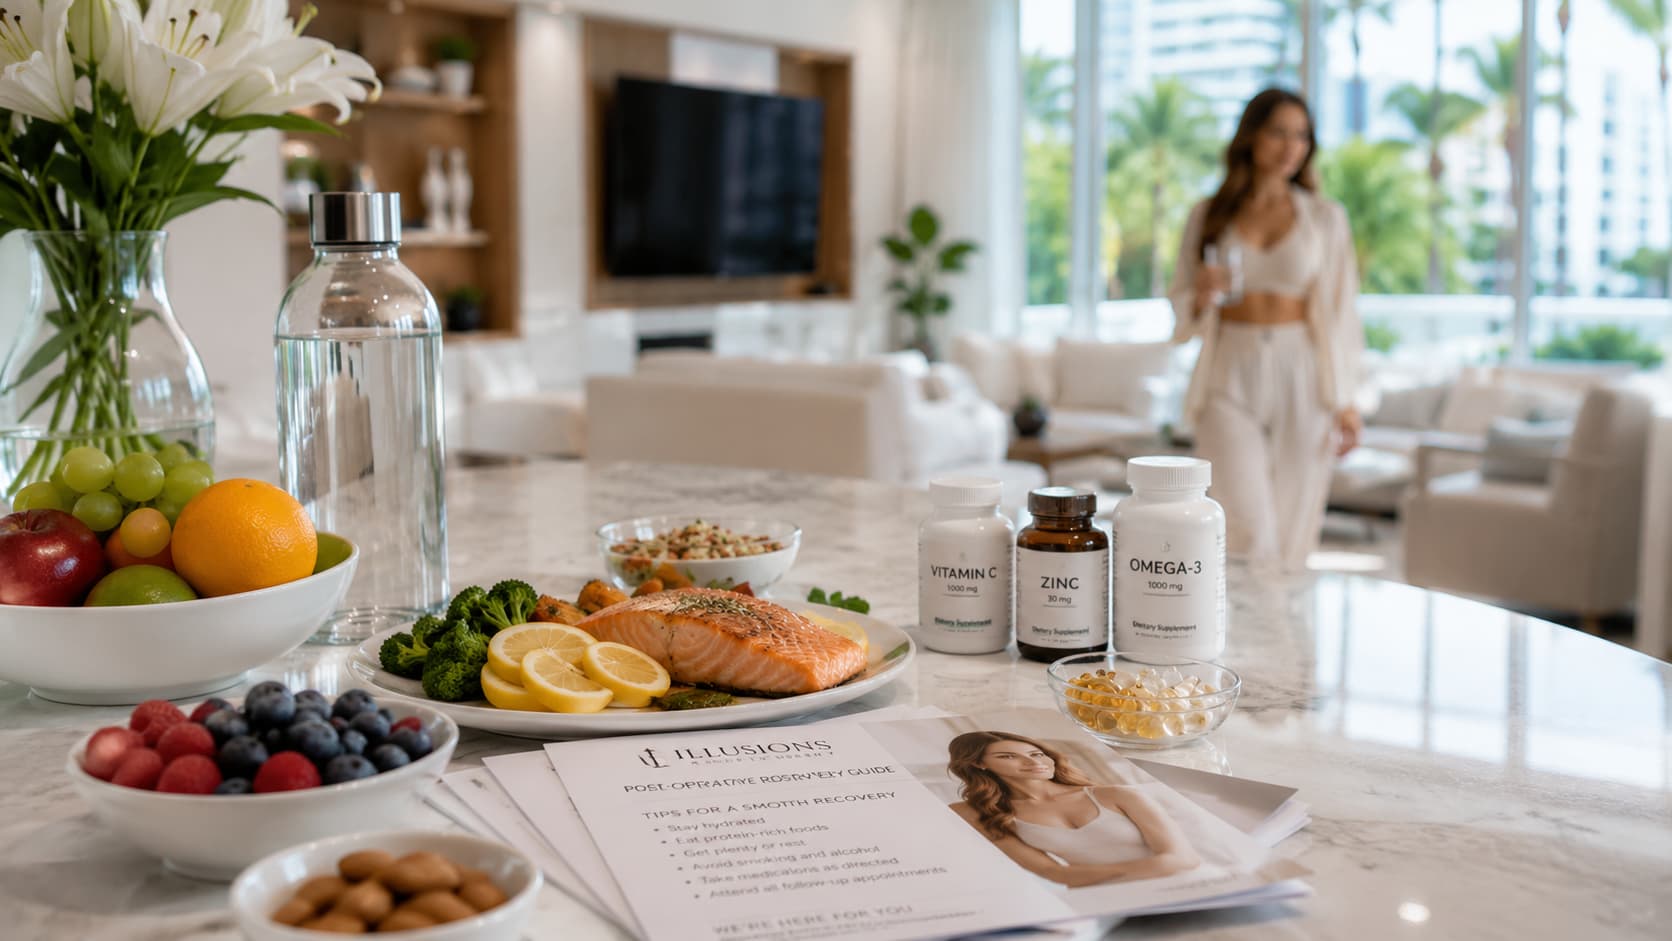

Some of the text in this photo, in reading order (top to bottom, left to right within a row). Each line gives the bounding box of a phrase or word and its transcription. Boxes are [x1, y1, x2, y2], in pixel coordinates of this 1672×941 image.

[930, 564, 997, 580] VITAMIN C
[1129, 558, 1202, 575] OMEGA-3
[947, 584, 978, 593] 1000 mg
[1040, 575, 1080, 590] ZINC
[1148, 580, 1183, 592] 1000 mg
[1059, 596, 1072, 604] mg
[675, 740, 832, 760] ILLUSIONS
[847, 764, 896, 777] GUIDE
[641, 809, 682, 820] TIPS
[686, 805, 721, 817] FOR
[727, 804, 739, 813] A
[812, 791, 896, 805] RECOVERY
[667, 816, 766, 833] Stay hydrated
[799, 849, 827, 860] and
[852, 865, 949, 884] appointments
